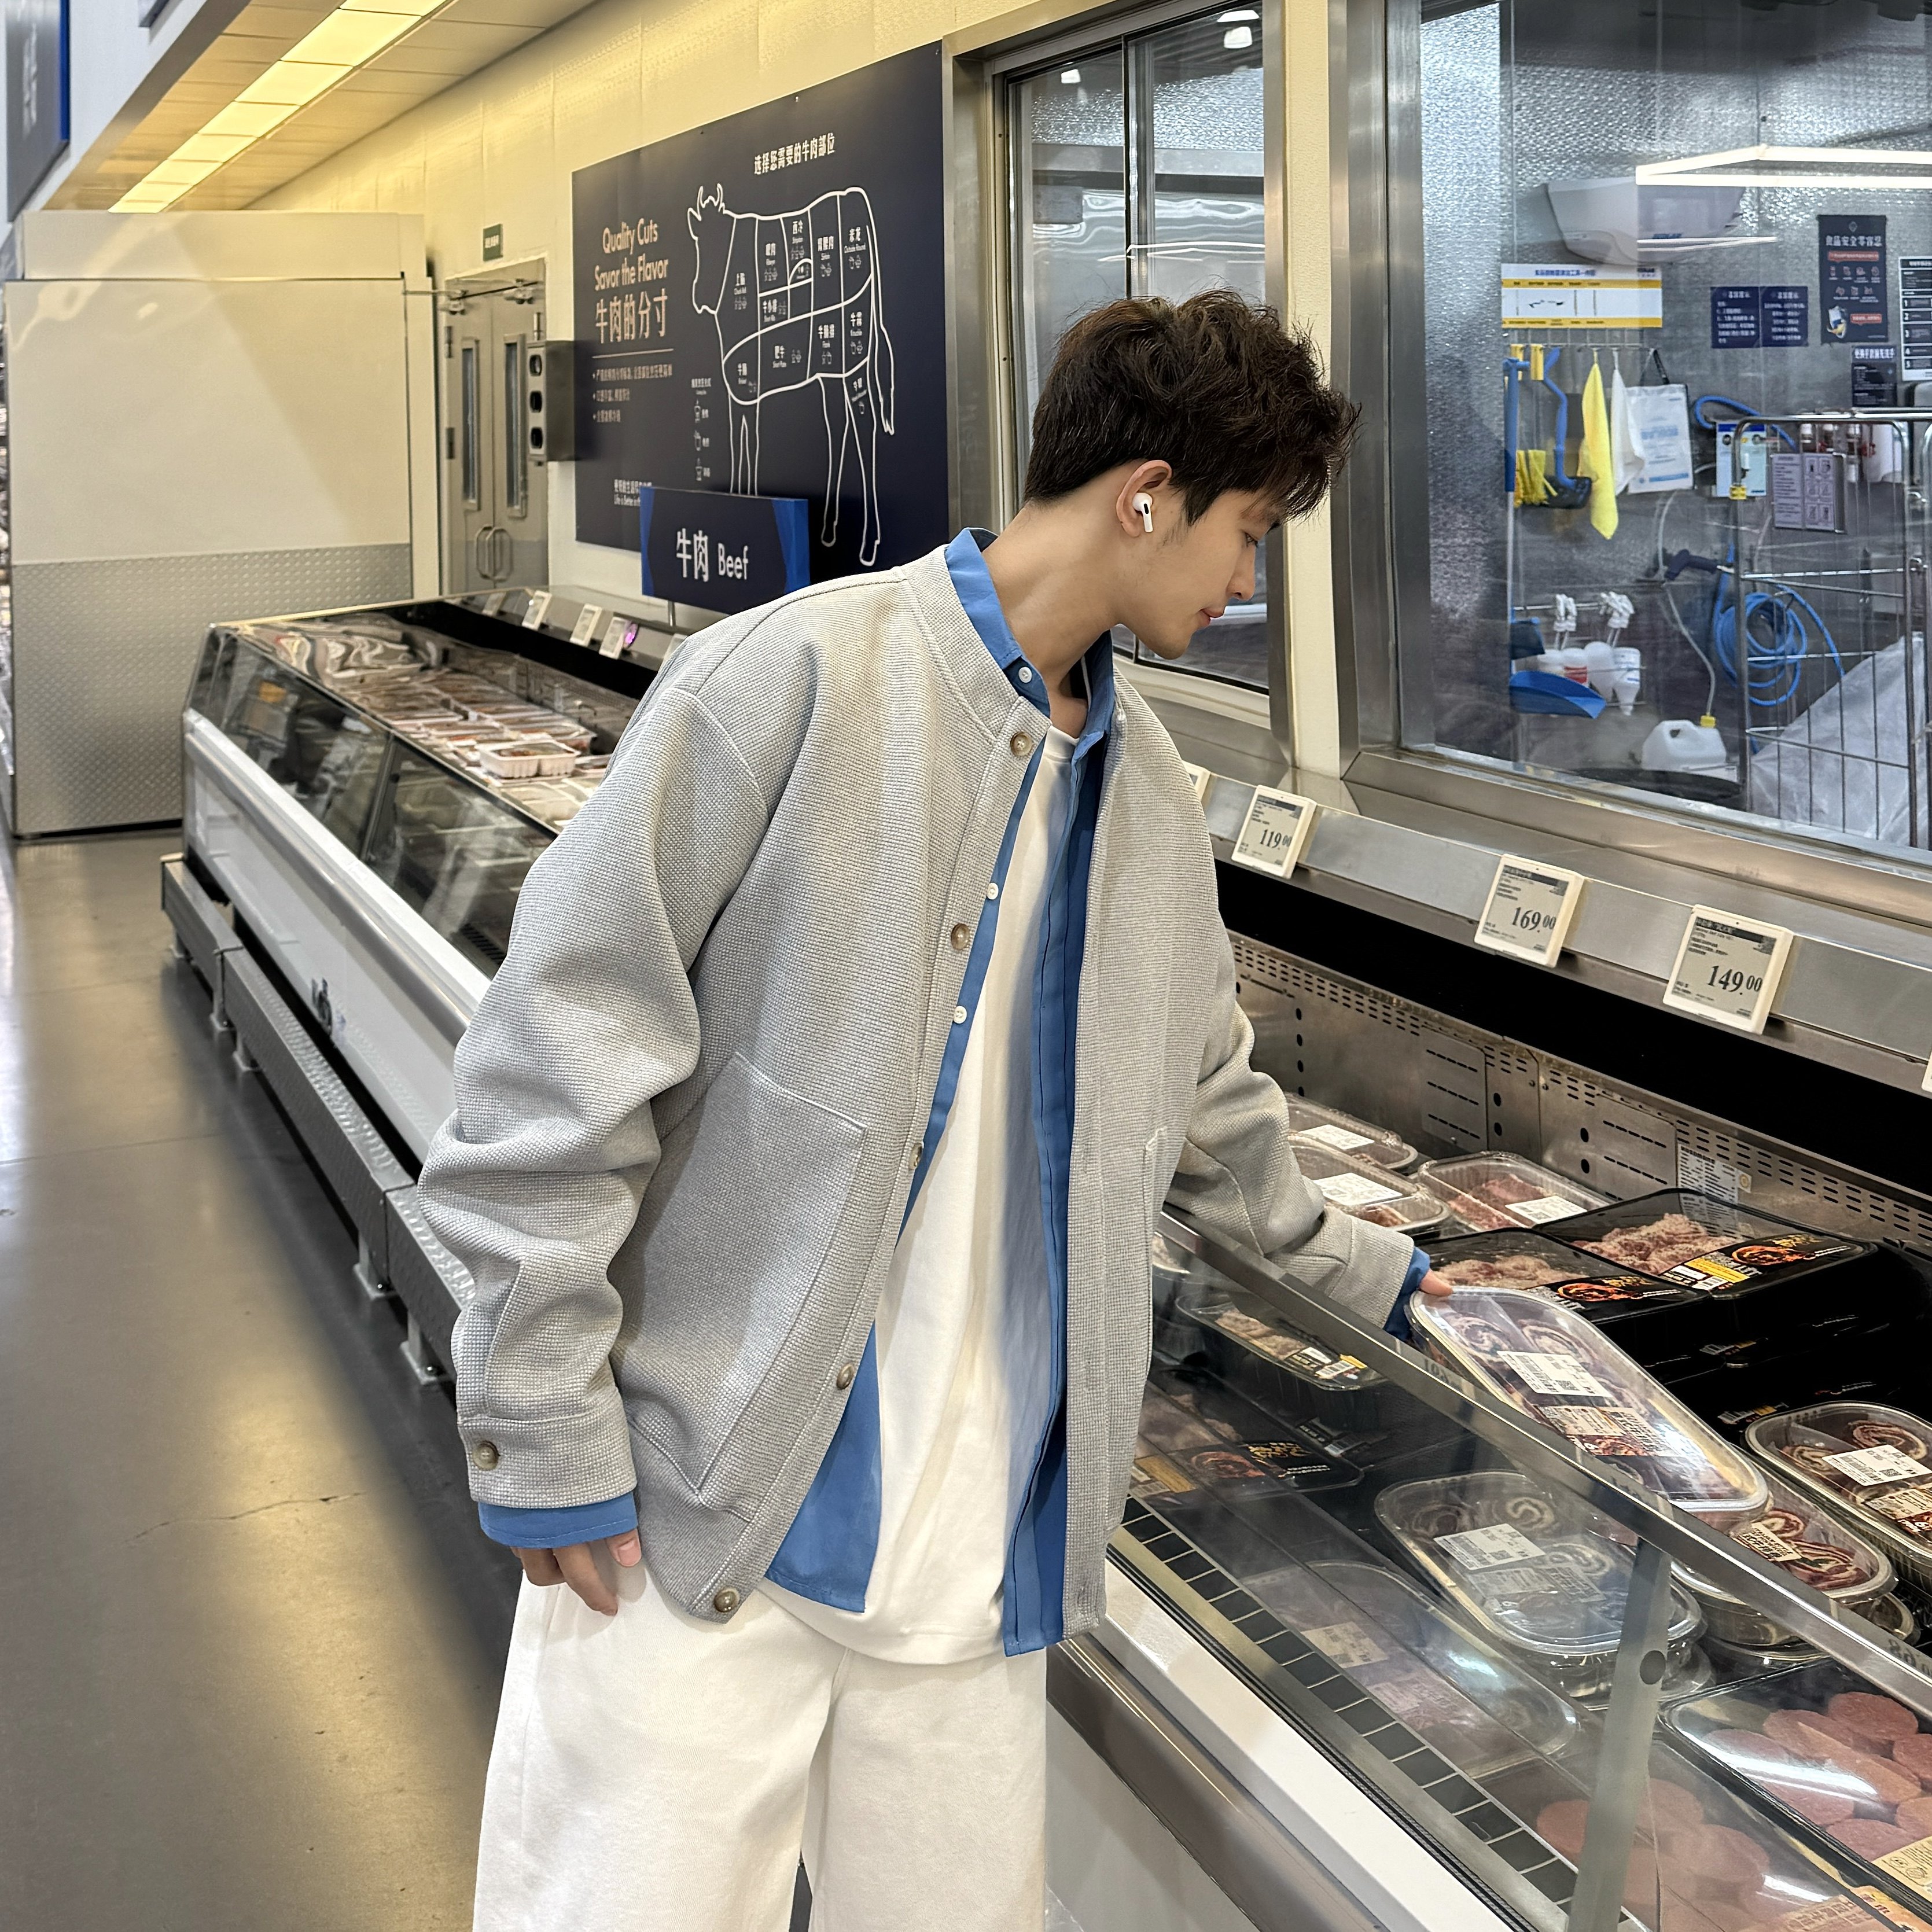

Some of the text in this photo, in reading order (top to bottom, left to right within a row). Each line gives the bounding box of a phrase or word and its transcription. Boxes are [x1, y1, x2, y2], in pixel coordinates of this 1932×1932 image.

[754, 133, 835, 175] 选择您需要的牛肉部位
[602, 218, 658, 255] Quality Cuts
[594, 253, 669, 291] Savor the Flavor
[595, 288, 668, 344] 牛肉的分寸
[676, 528, 749, 582] 牛肉 Beef
[1260, 829, 1293, 851] 119.00
[1512, 907, 1557, 933] 169.00
[1707, 965, 1764, 995] 149.00
